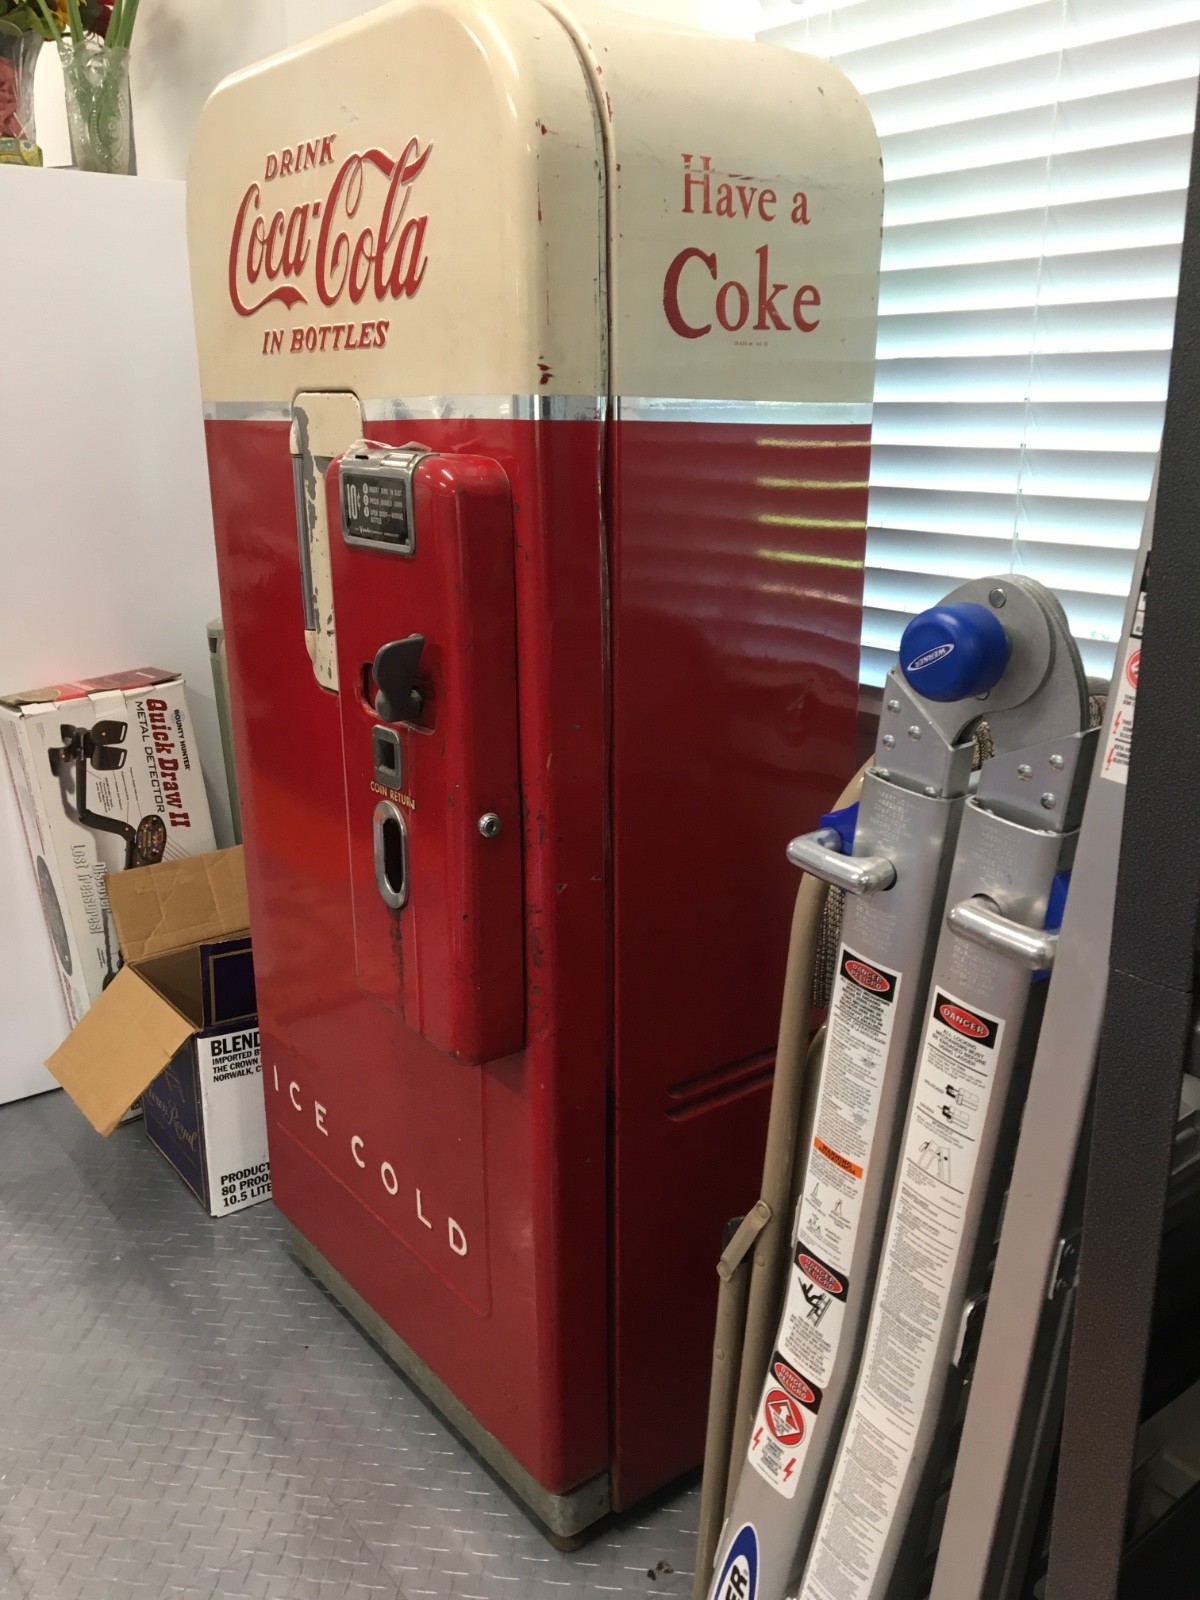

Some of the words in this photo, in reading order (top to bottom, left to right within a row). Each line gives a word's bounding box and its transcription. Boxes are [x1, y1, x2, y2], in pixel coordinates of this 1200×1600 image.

[264, 133, 337, 182] DRINK
[681, 153, 777, 222] Have
[790, 192, 811, 225] a
[229, 135, 433, 316] Coca-Cola
[662, 244, 821, 339] Coke
[262, 329, 284, 354] IN
[289, 319, 389, 353] BOTTLES
[914, 647, 947, 668] WERNER
[146, 698, 175, 755] Quick
[174, 709, 184, 739] BOUNTY
[180, 740, 191, 770] HUNTER
[135, 701, 150, 743] METAL
[144, 746, 165, 813] DETECTOR
[158, 757, 182, 809] Draw
[370, 780, 388, 797] COIN
[389, 789, 416, 810] RETURN
[850, 970, 882, 990] PELIGRO
[852, 963, 882, 983] DANGER
[943, 1007, 985, 1035] DANGER
[212, 1050, 253, 1066] IMPORTED
[213, 1064, 228, 1075] THE
[229, 1057, 259, 1072] CROWN
[213, 1067, 254, 1083] NORWALK,
[274, 1064, 328, 1136] ICE
[220, 1162, 271, 1185] PRODUCT
[221, 1184, 237, 1197] 80
[239, 1172, 271, 1191] PROO
[223, 1191, 248, 1208] 10.5
[351, 1135, 467, 1257] COLD
[803, 1263, 835, 1291] PELIGRO
[805, 1258, 836, 1284] DANGER
[778, 1371, 807, 1400] PELIGRO
[780, 1366, 808, 1394] DANGER
